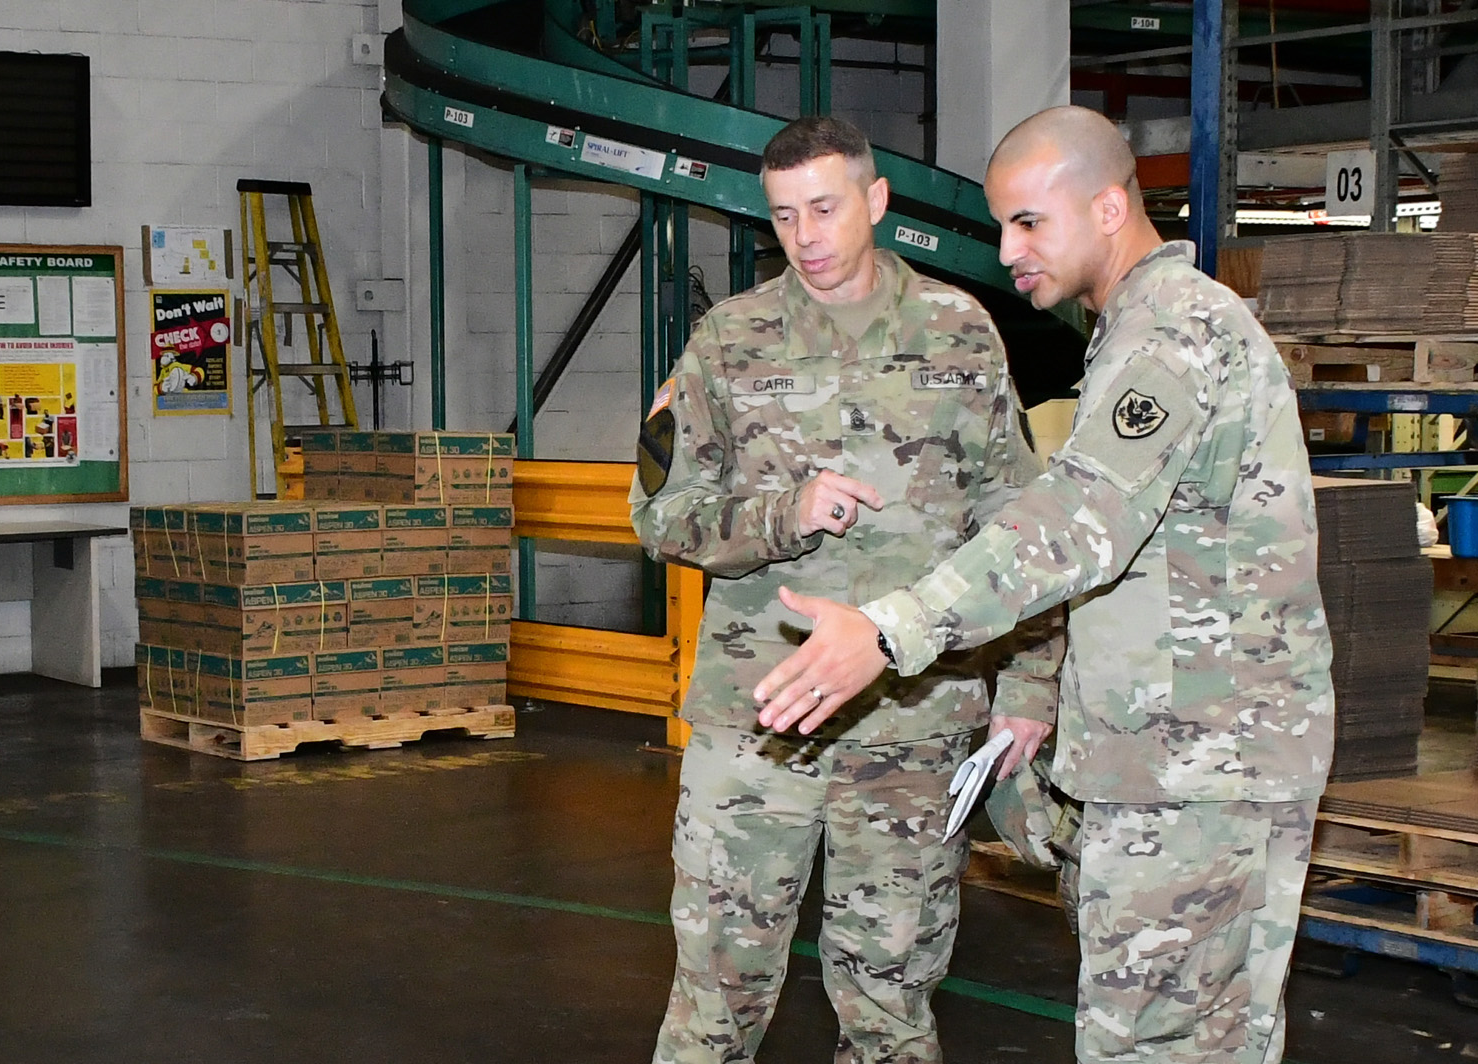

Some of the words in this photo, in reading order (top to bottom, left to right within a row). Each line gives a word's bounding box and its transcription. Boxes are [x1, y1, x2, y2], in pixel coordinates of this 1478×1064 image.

[446, 109, 468, 124] P-103
[1337, 166, 1362, 202] 03
[897, 229, 931, 247] P-103
[47, 257, 93, 268] BOARD
[155, 303, 191, 321] Don't
[192, 296, 224, 313] Wait
[154, 326, 201, 347] CHECK
[753, 378, 794, 392] CARR
[449, 445, 460, 454] 30
